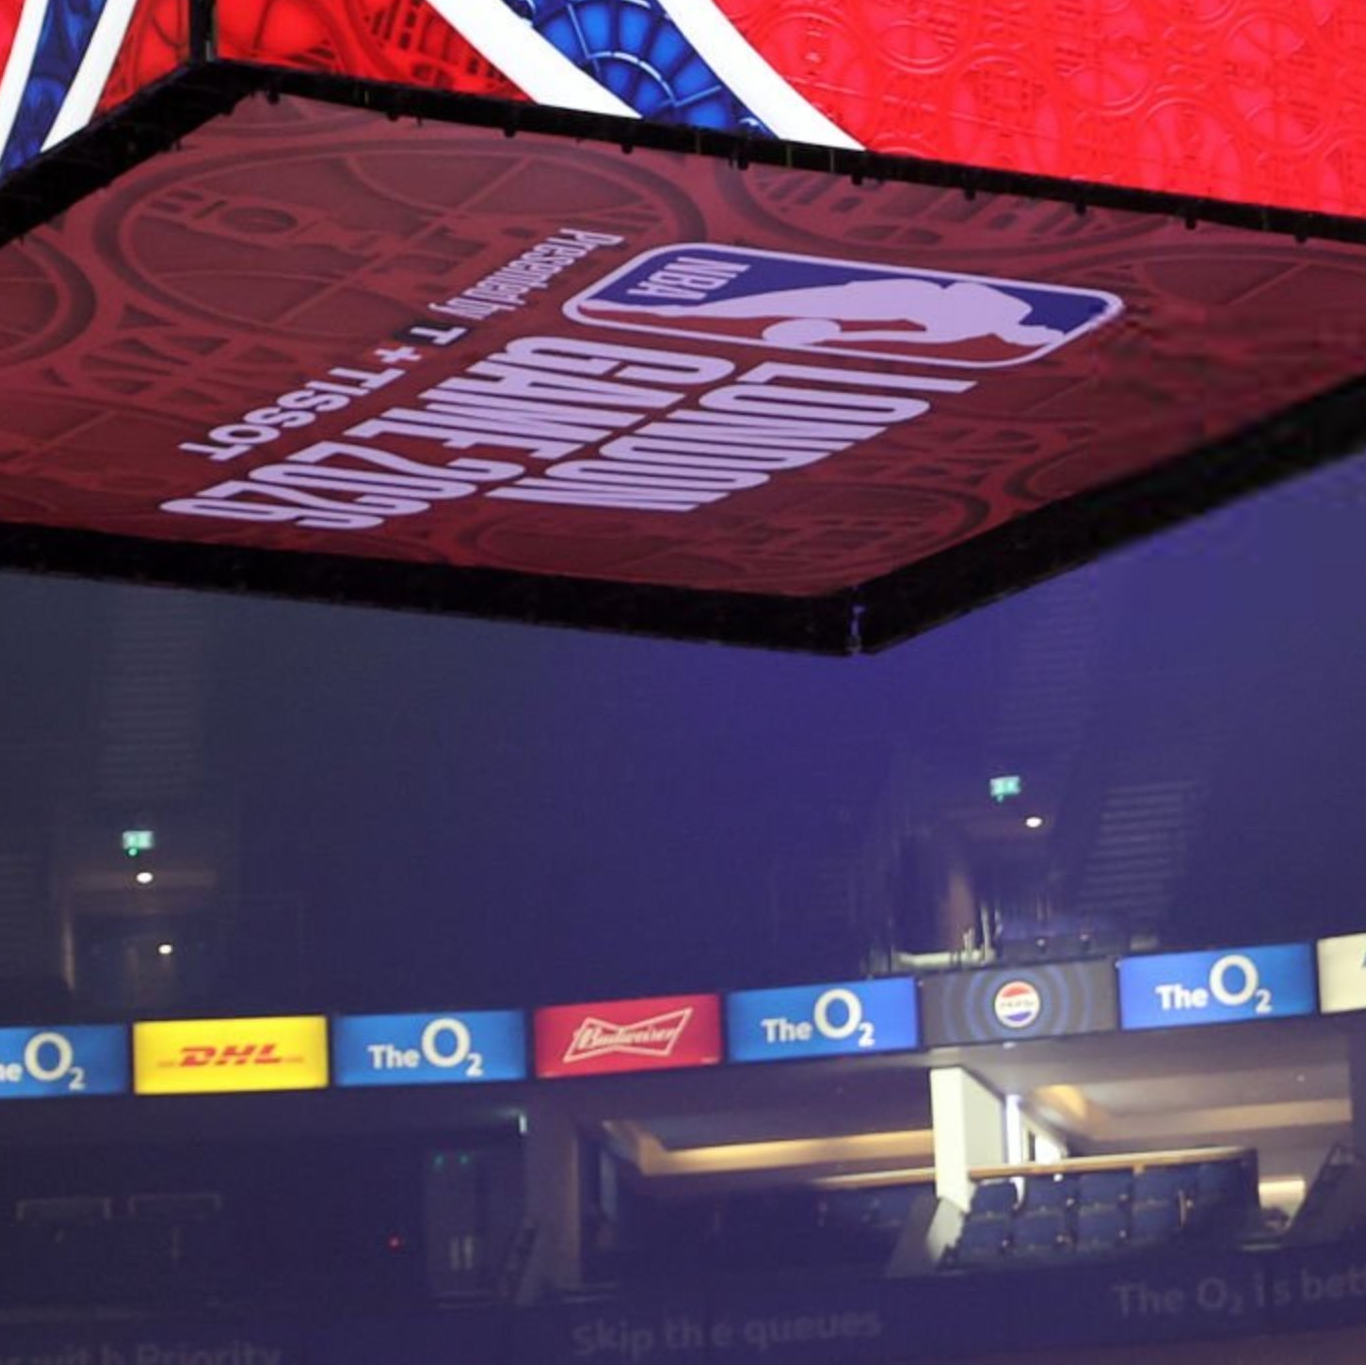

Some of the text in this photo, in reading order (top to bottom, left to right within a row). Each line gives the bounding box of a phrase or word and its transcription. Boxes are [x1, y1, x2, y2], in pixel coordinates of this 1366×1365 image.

[462, 227, 625, 307] Presented
[626, 255, 751, 301] NBA
[428, 290, 516, 321] by
[178, 366, 406, 462] TISSOT
[158, 335, 736, 530] GAME 2026
[484, 361, 979, 512] LONDON
[1154, 984, 1209, 1013] The
[577, 1021, 681, 1050] Budweiser
[760, 1018, 812, 1044] The
[179, 1043, 282, 1067] DHL
[367, 1044, 421, 1070] The
[1112, 1283, 1185, 1317] The
[572, 1317, 655, 1361] Skip
[743, 1308, 884, 1353] queues
